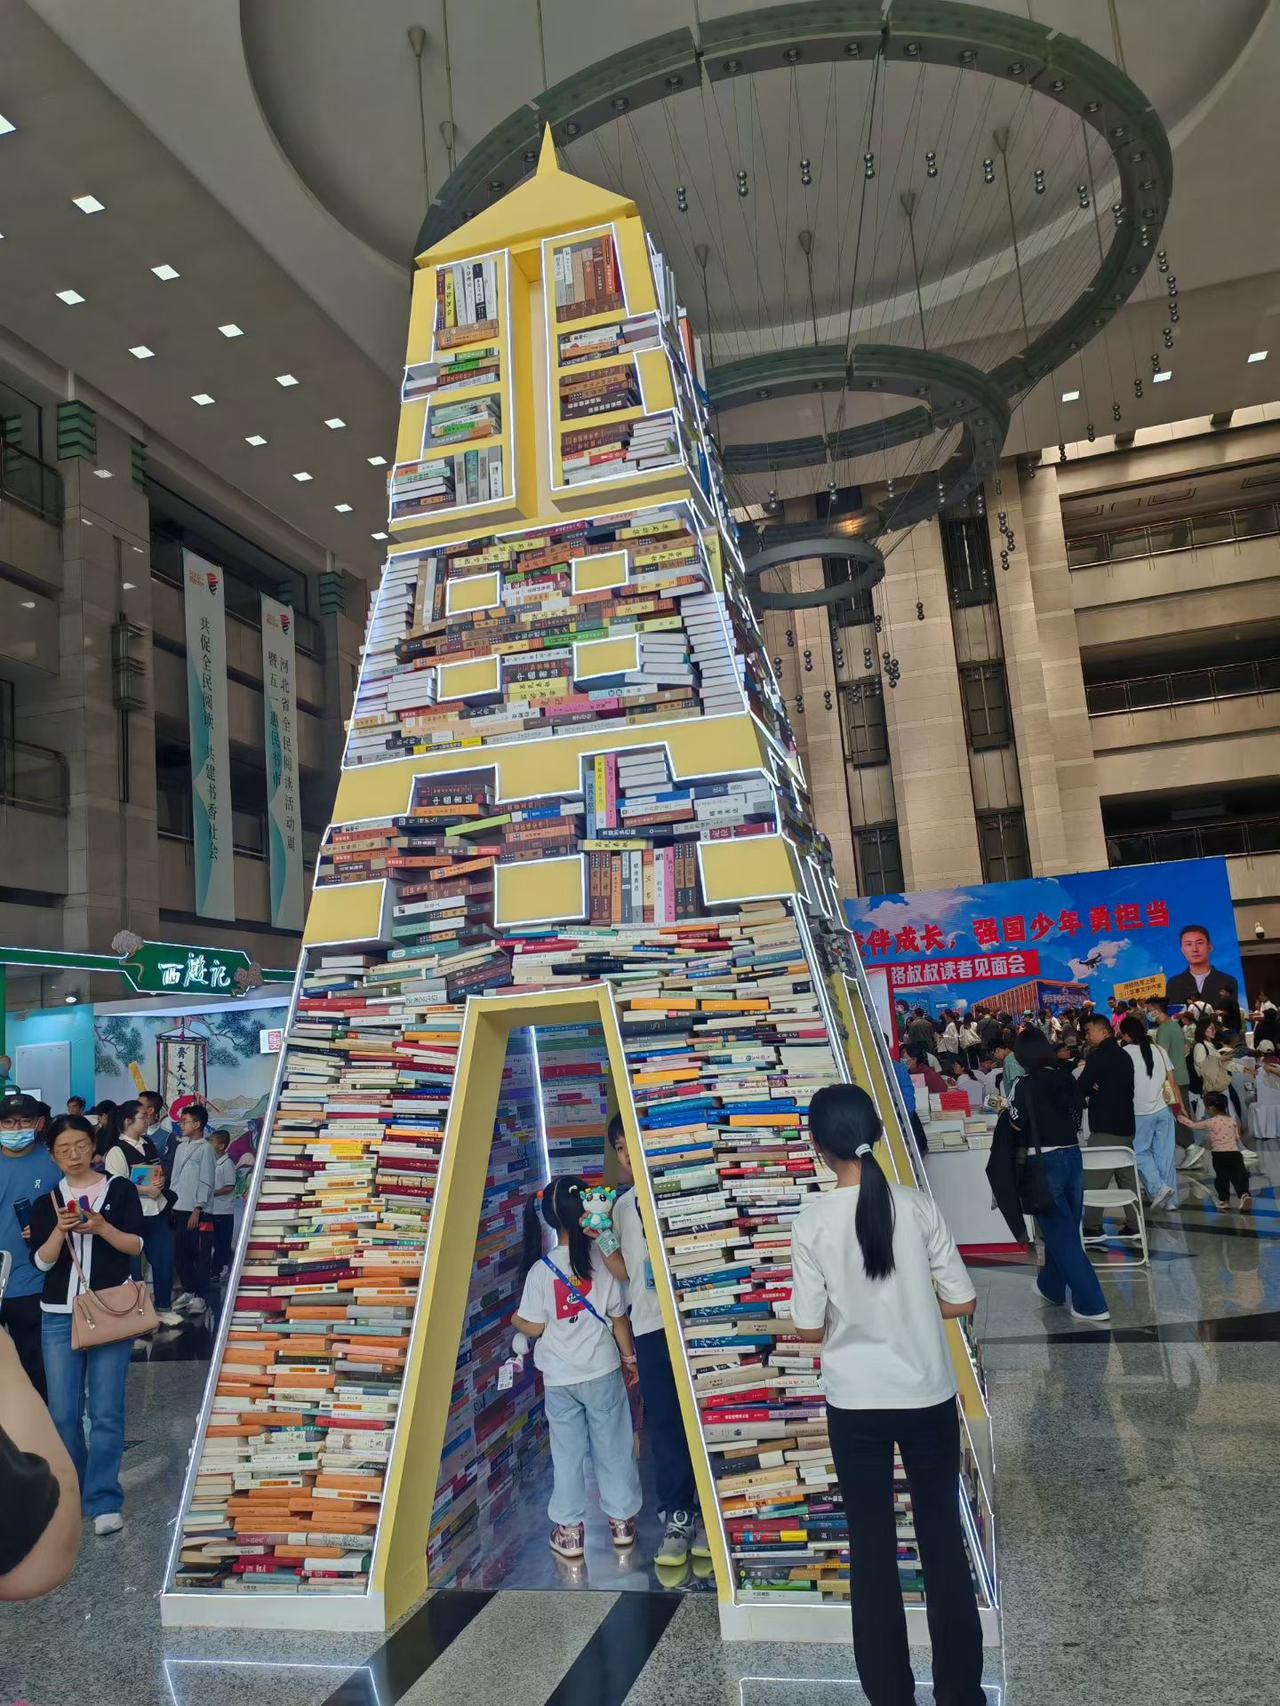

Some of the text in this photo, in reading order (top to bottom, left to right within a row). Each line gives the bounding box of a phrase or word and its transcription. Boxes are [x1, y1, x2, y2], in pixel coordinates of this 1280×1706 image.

[890, 954, 1026, 985] 路叔叔读者见面会
